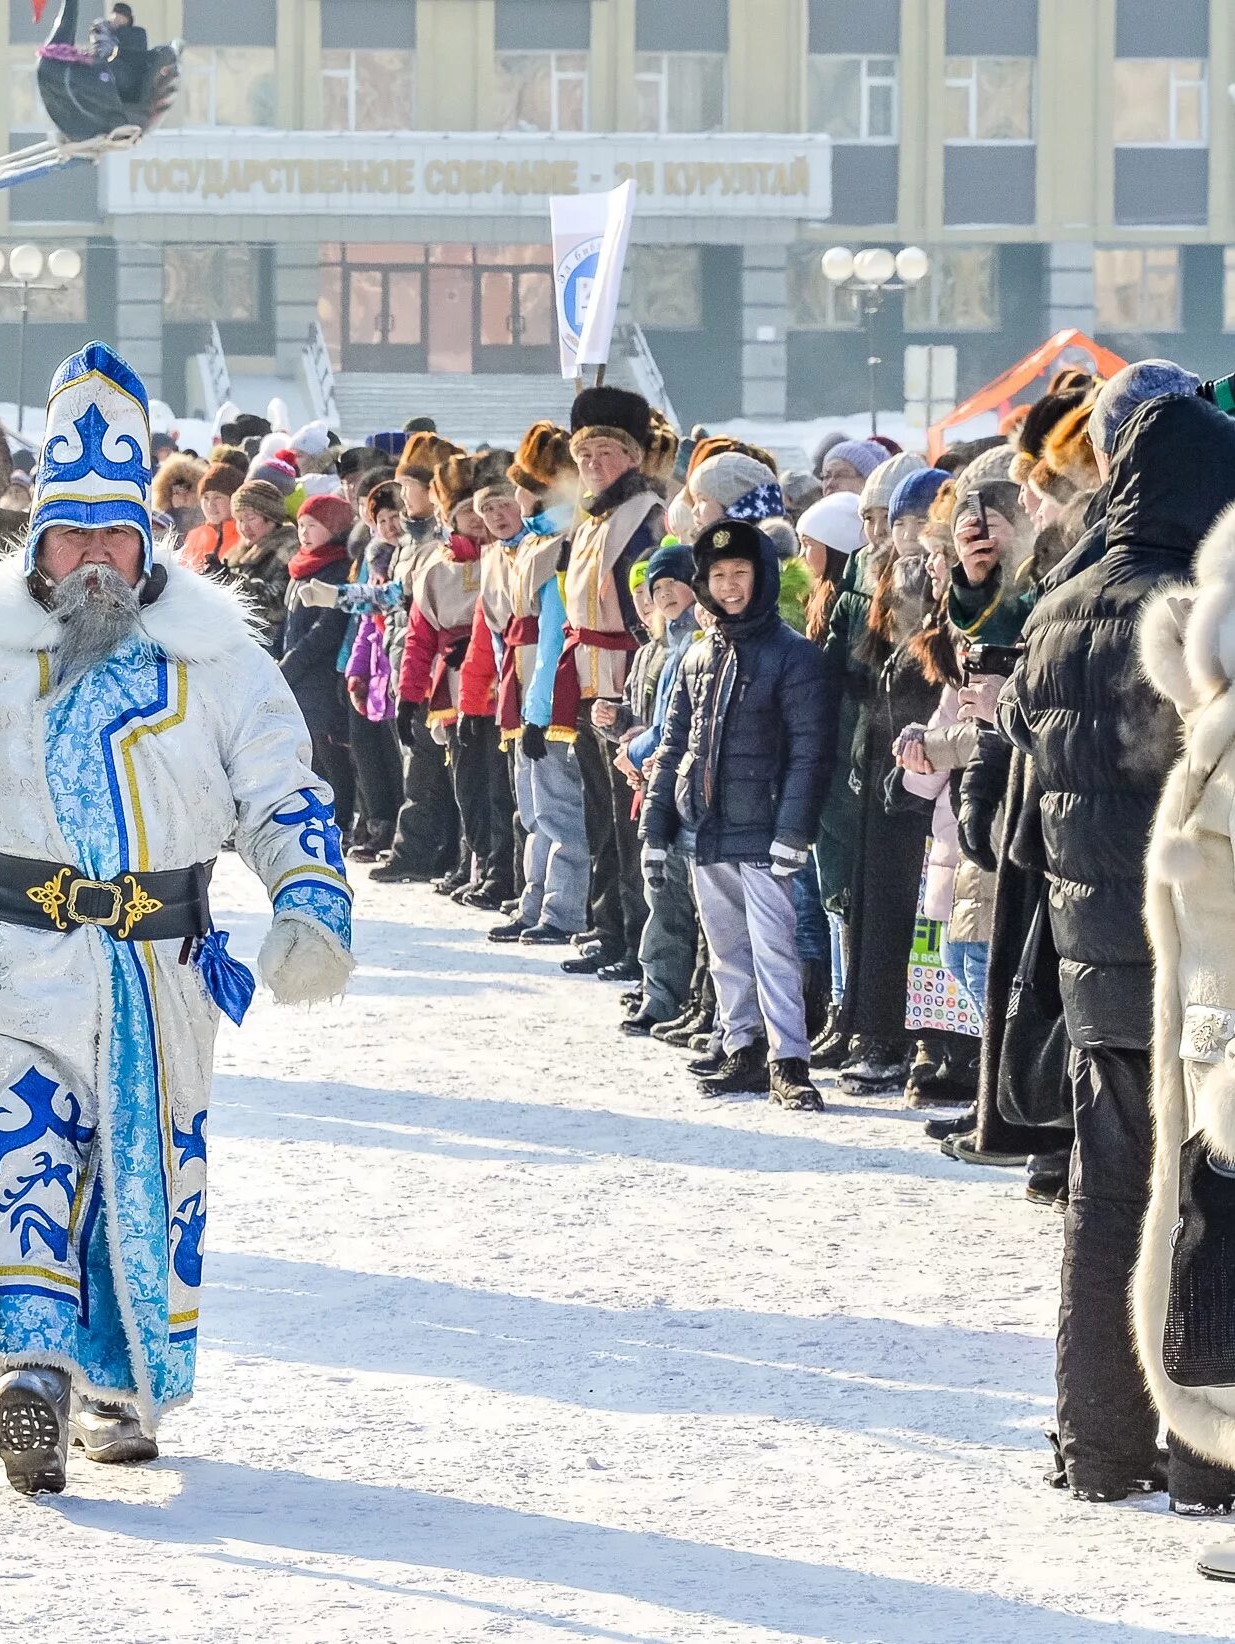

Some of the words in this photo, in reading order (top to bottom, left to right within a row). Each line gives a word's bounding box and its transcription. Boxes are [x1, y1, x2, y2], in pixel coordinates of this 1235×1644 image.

[129, 158, 414, 198] ГОСУДАРСТВЕННОЕ
[425, 158, 579, 195] СОБРАНИЕ
[665, 156, 809, 196] КУРУЛТАЙ
